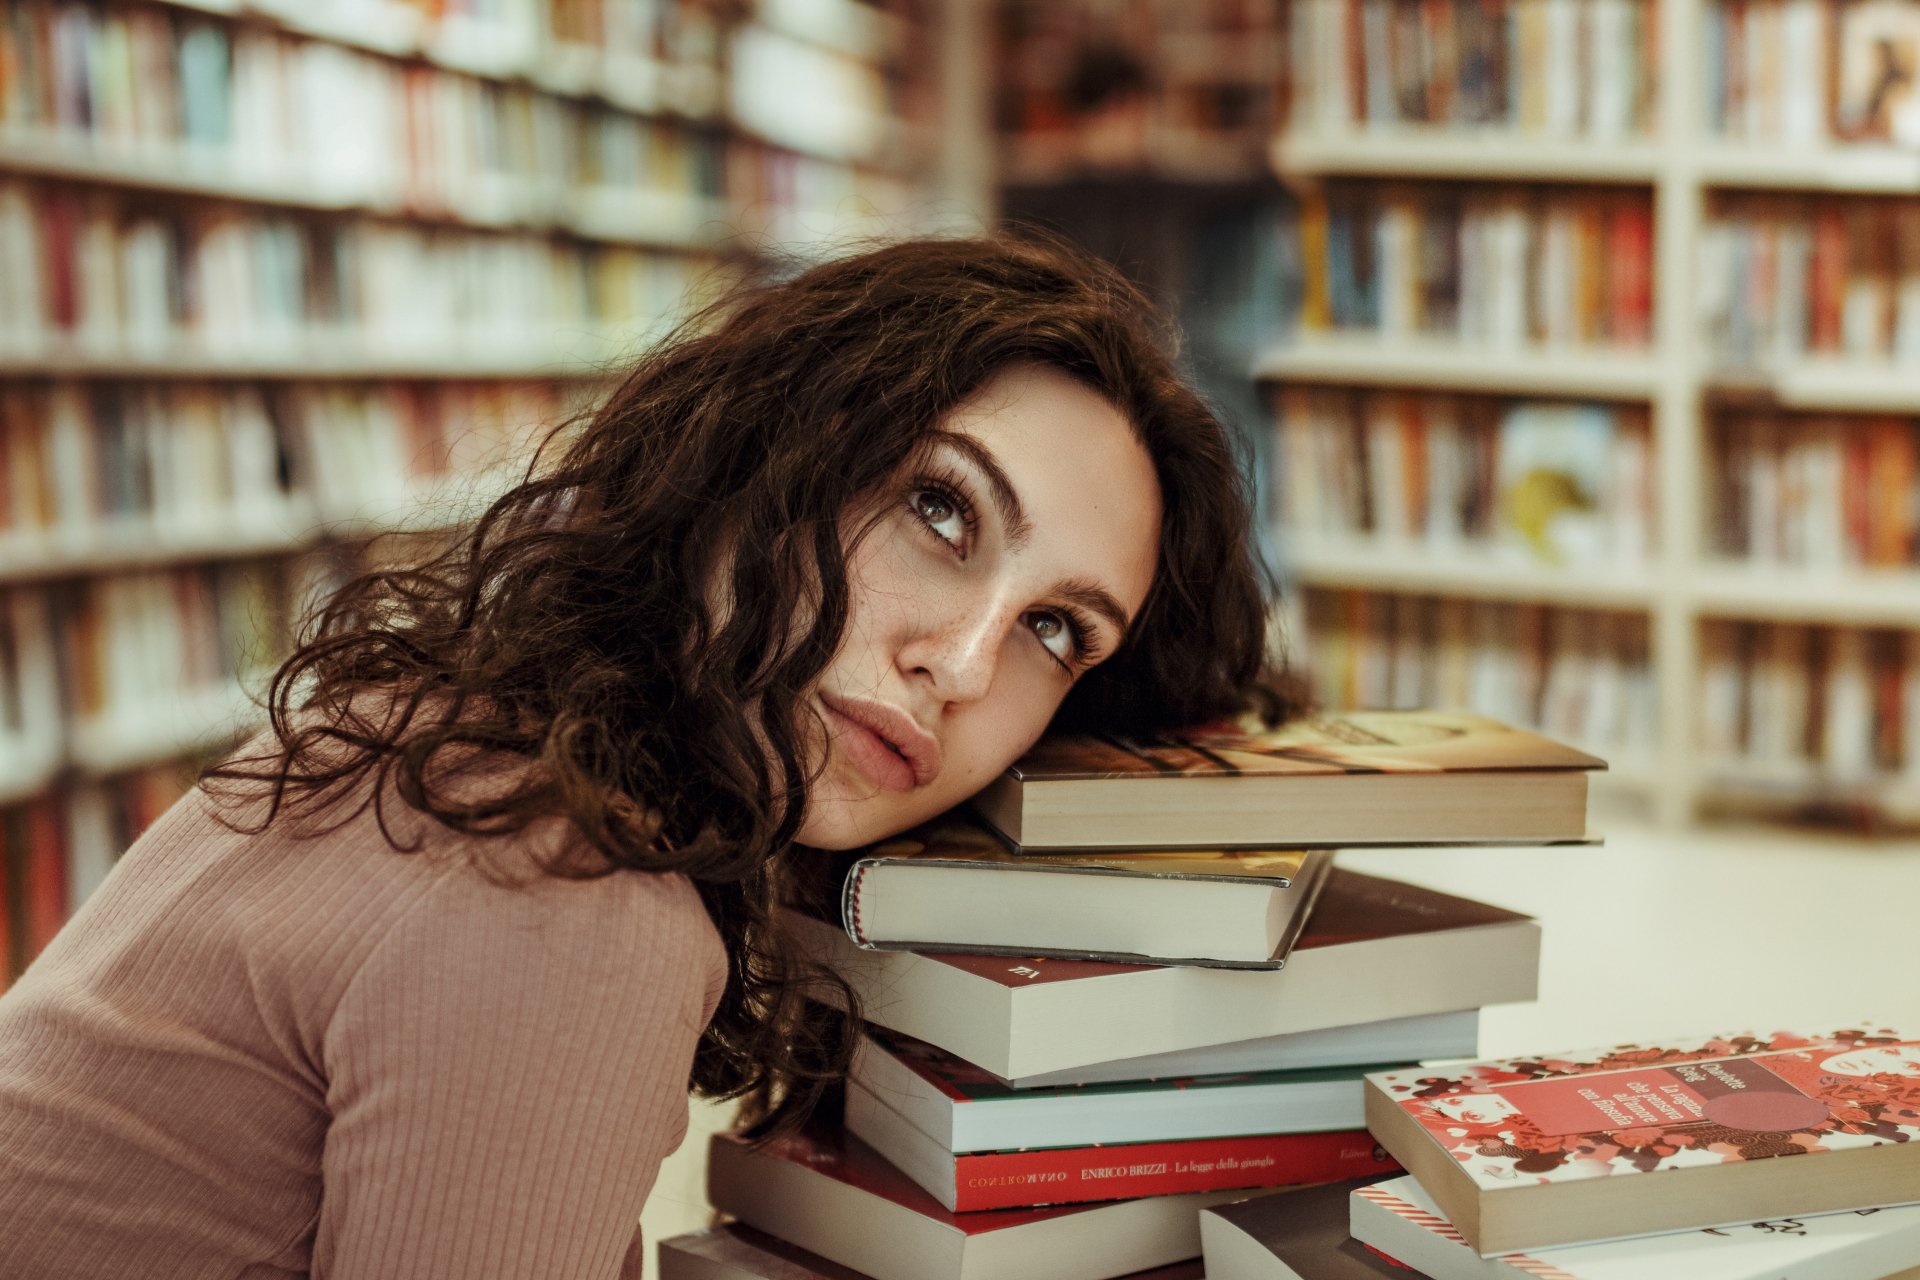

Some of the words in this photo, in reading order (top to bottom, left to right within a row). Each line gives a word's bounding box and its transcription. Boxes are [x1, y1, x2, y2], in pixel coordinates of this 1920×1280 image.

[1676, 1065, 1707, 1082] Greig
[1701, 1062, 1746, 1090] Charlotte
[1626, 1081, 1649, 1094] che
[1639, 1094, 1684, 1121] pensava
[1659, 1084, 1679, 1094] La
[1577, 1088, 1600, 1101] con
[1592, 1098, 1634, 1126] filosofia
[1081, 1166, 1127, 1180] ENRICO
[1129, 1163, 1167, 1176] BRIZZI
[1175, 1161, 1188, 1173] La
[1190, 1159, 1214, 1173] legge
[1216, 1157, 1238, 1169] della
[1240, 1155, 1275, 1170] giungla
